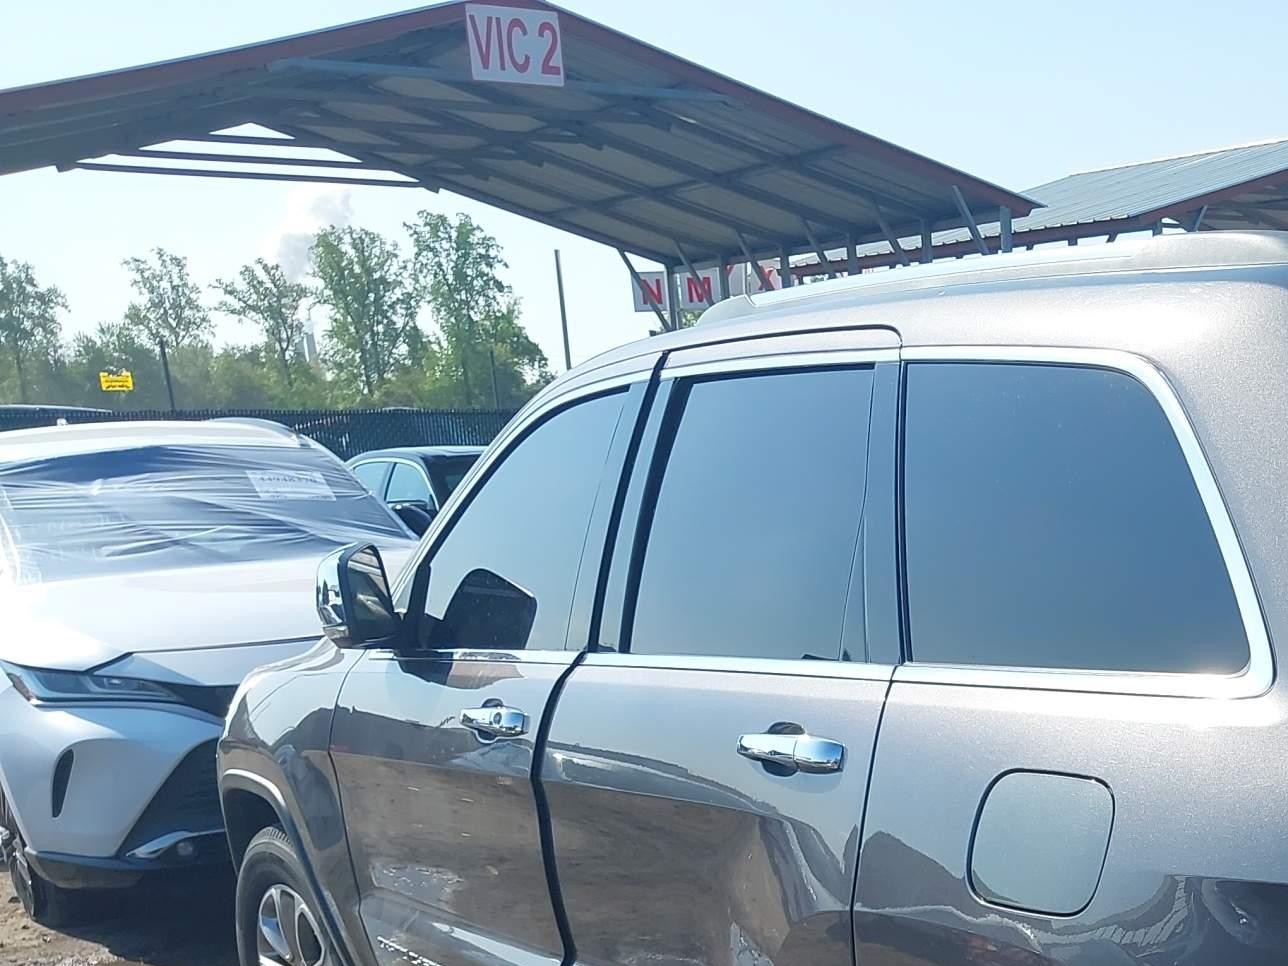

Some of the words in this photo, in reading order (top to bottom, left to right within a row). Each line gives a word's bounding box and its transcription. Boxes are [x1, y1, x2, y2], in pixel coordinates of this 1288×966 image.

[468, 14, 531, 73] VIC
[538, 21, 562, 76] 2
[641, 278, 663, 305] N
[686, 275, 713, 304] M
